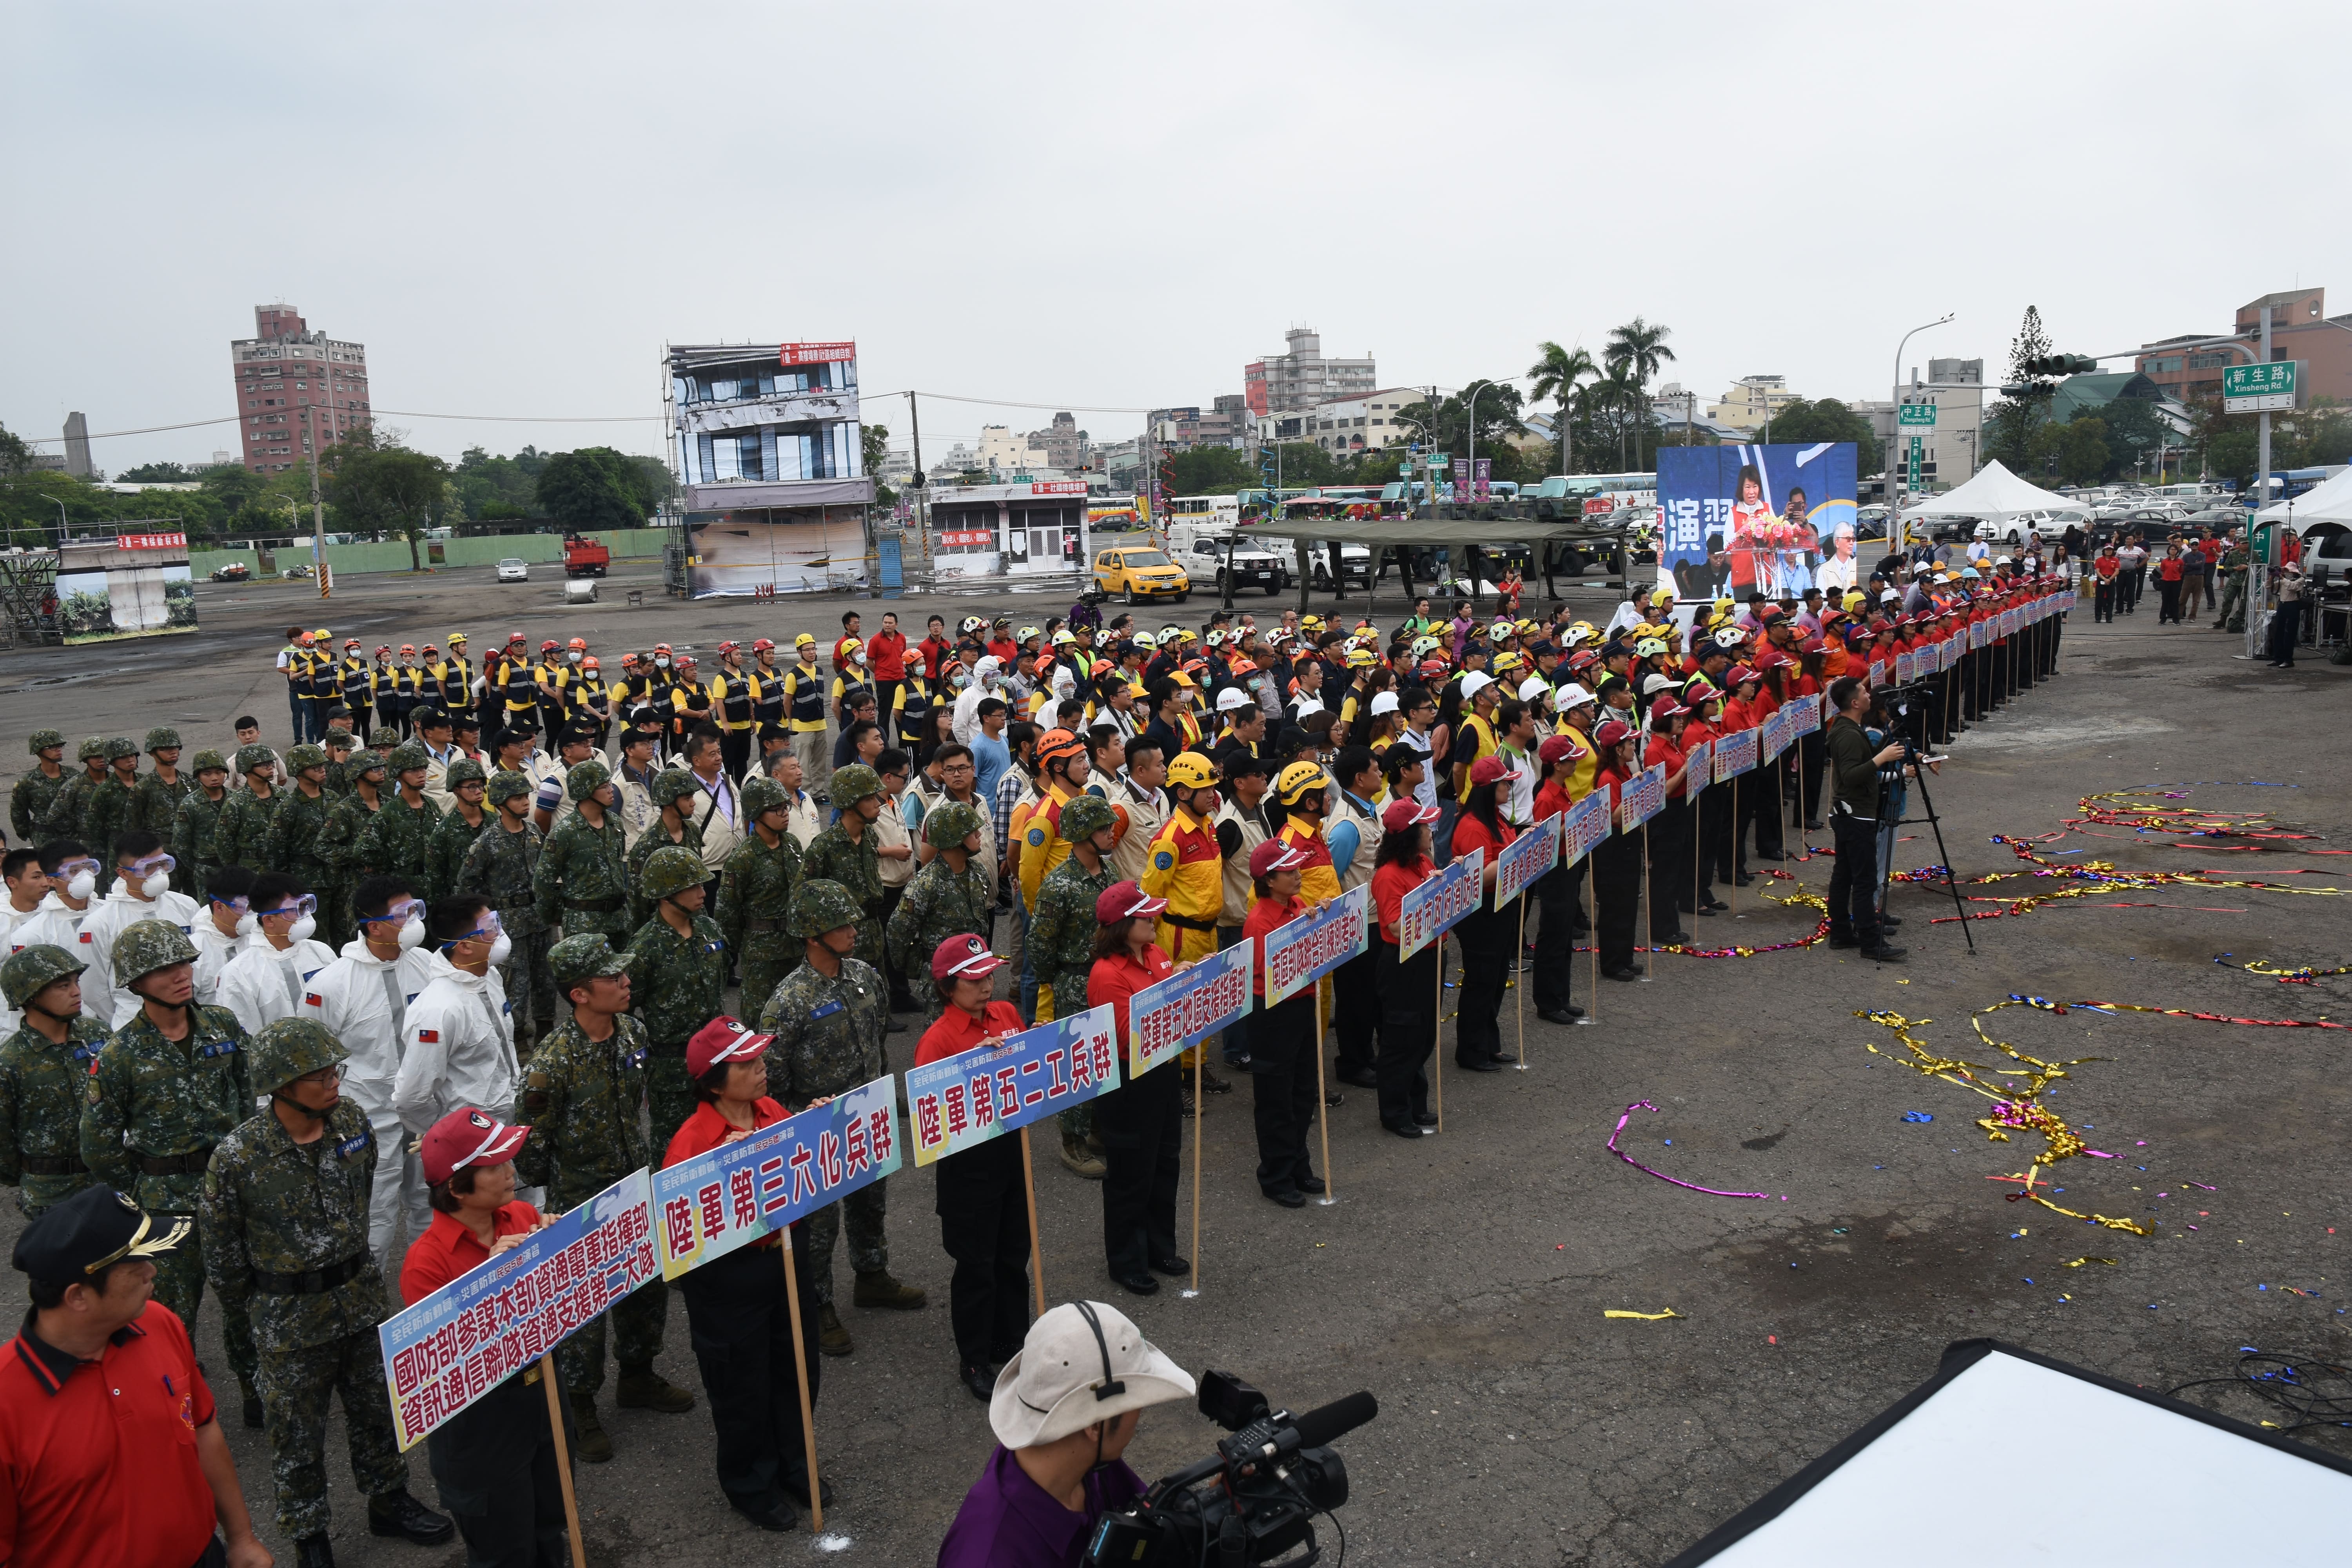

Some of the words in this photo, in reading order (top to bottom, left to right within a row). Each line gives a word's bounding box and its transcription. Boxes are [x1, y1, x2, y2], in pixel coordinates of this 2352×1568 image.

[1904, 407, 1931, 416] 中正路
[2233, 366, 2285, 383] 新生路
[1404, 867, 1480, 951] 高雄市政府消防局
[1502, 833, 1554, 898] 嘉義後備指揮部
[1272, 906, 1364, 994] 南區部隊聯合訓練測考中心
[1140, 965, 1247, 1062] 陸軍第五地區支援指揮部
[917, 1031, 1111, 1149] 陸軍第五二工兵群
[666, 1106, 892, 1259] 陸軍第三六化兵群
[393, 1201, 649, 1397] 國防部參謀本部資通電軍指揮部
[400, 1243, 655, 1443] 資訊通信聯隊資通支援第二大隊
